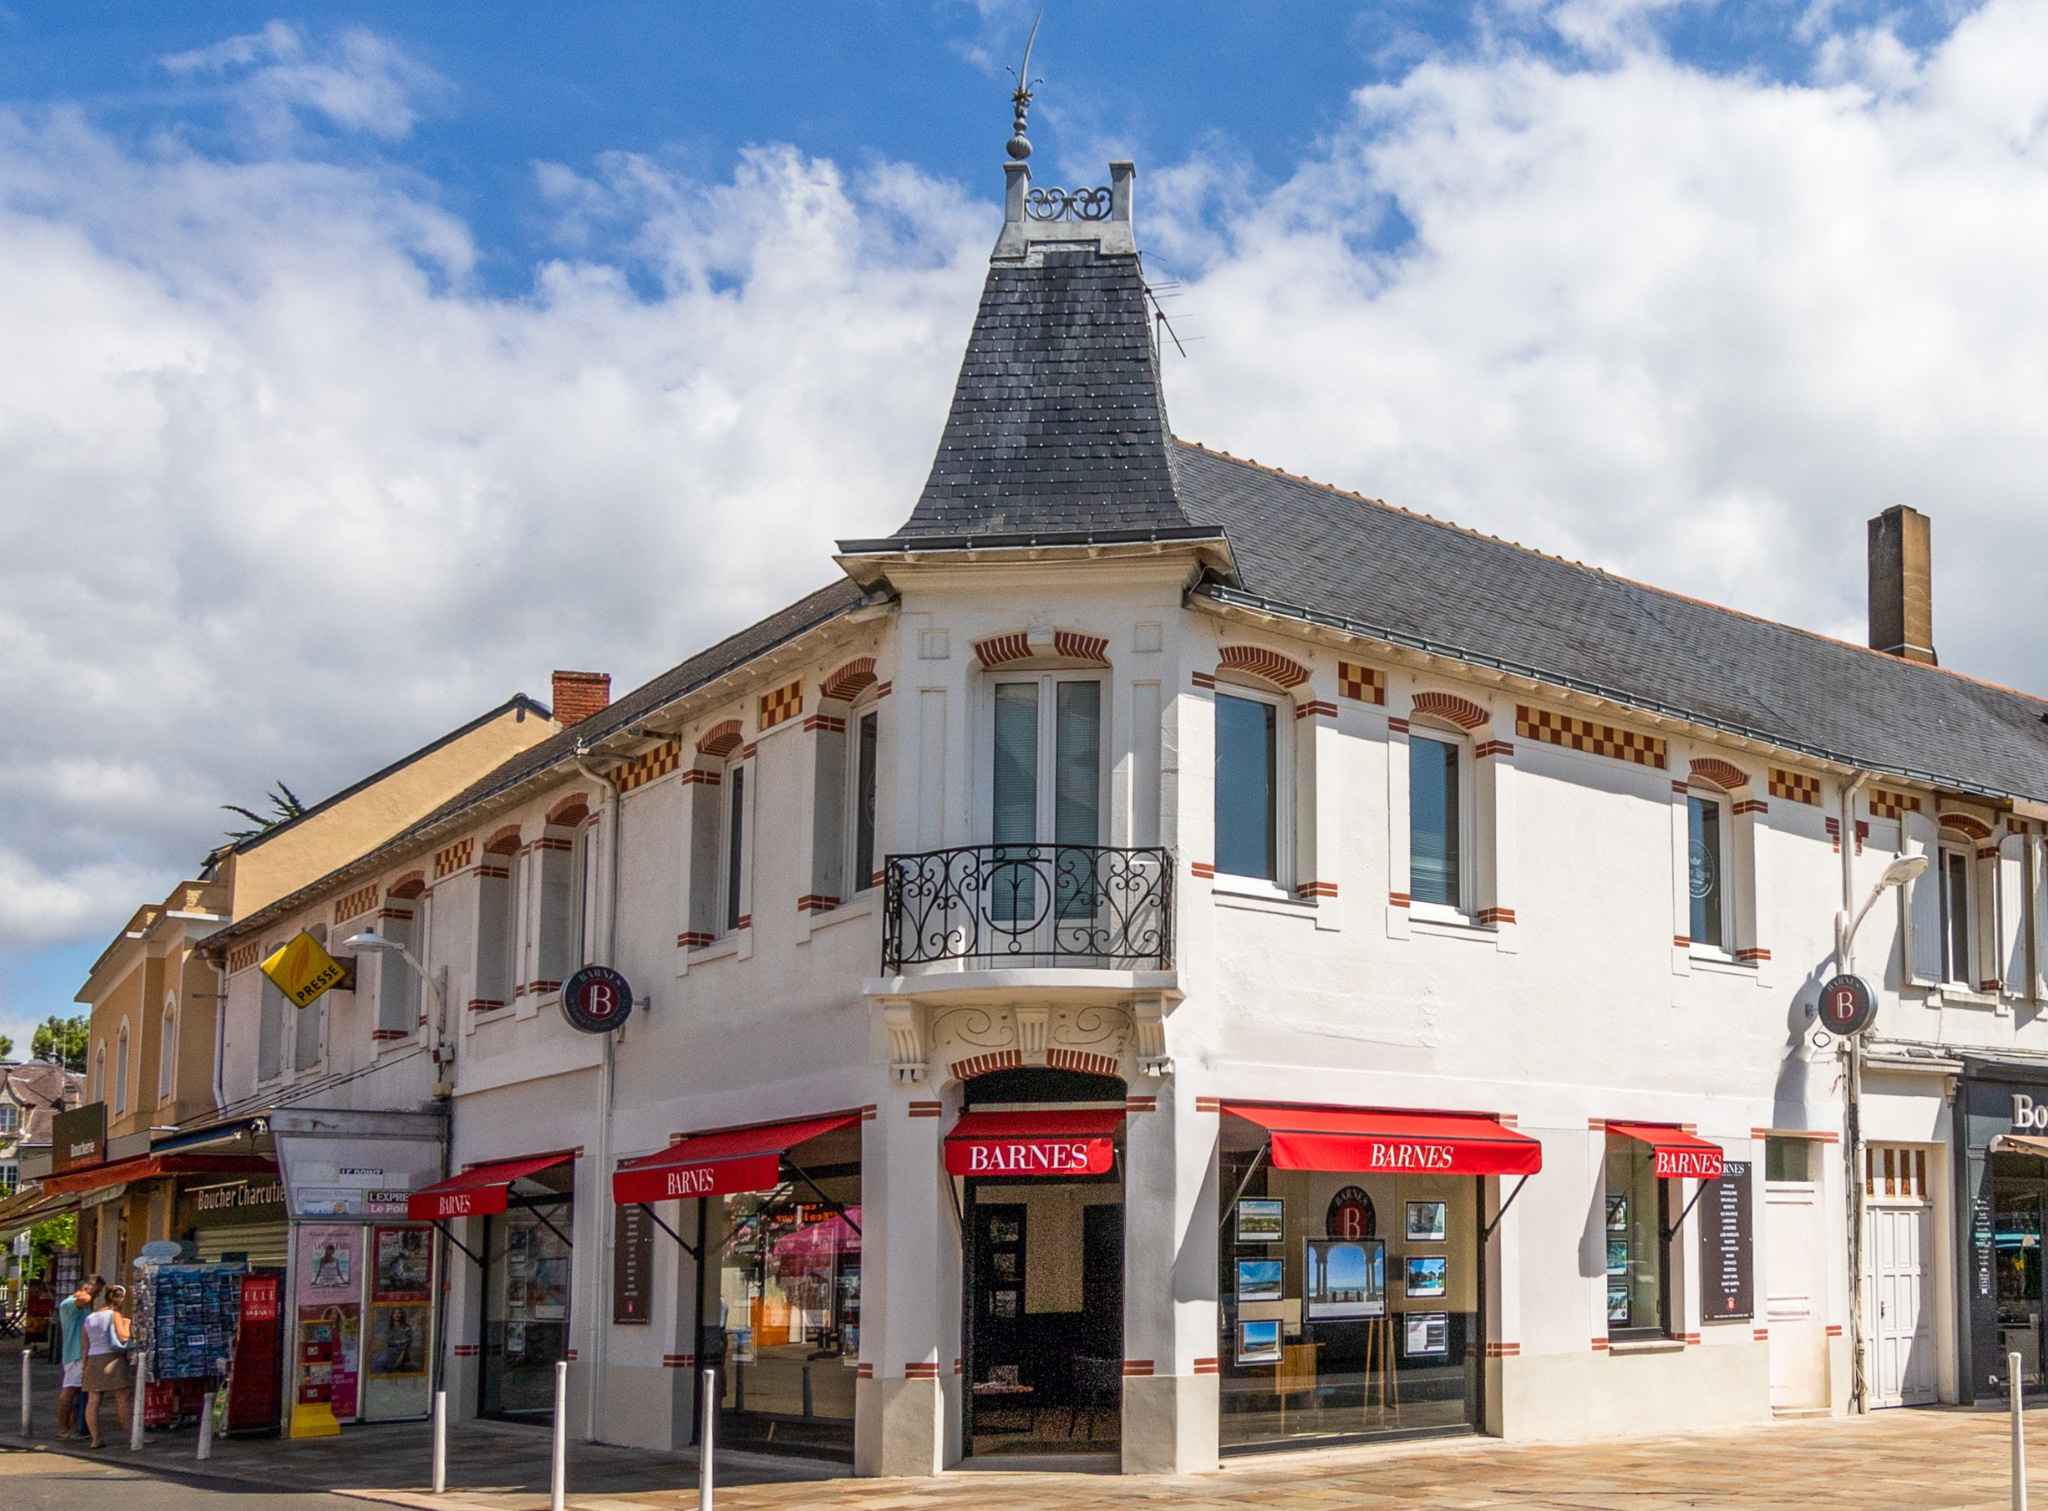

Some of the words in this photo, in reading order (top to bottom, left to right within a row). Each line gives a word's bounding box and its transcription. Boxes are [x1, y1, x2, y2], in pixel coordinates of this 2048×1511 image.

[297, 964, 338, 1001] PRESSE
[590, 985, 612, 1014] B
[1836, 992, 1854, 1019] B
[2011, 1094, 2048, 1128] Bo
[969, 1144, 1088, 1170] BARNES
[1370, 1143, 1454, 1168] BARNES
[1656, 1152, 1722, 1174] BARNES
[668, 1168, 714, 1195] BARNES
[198, 1188, 236, 1210] Boucher
[439, 1194, 471, 1215] BARNES
